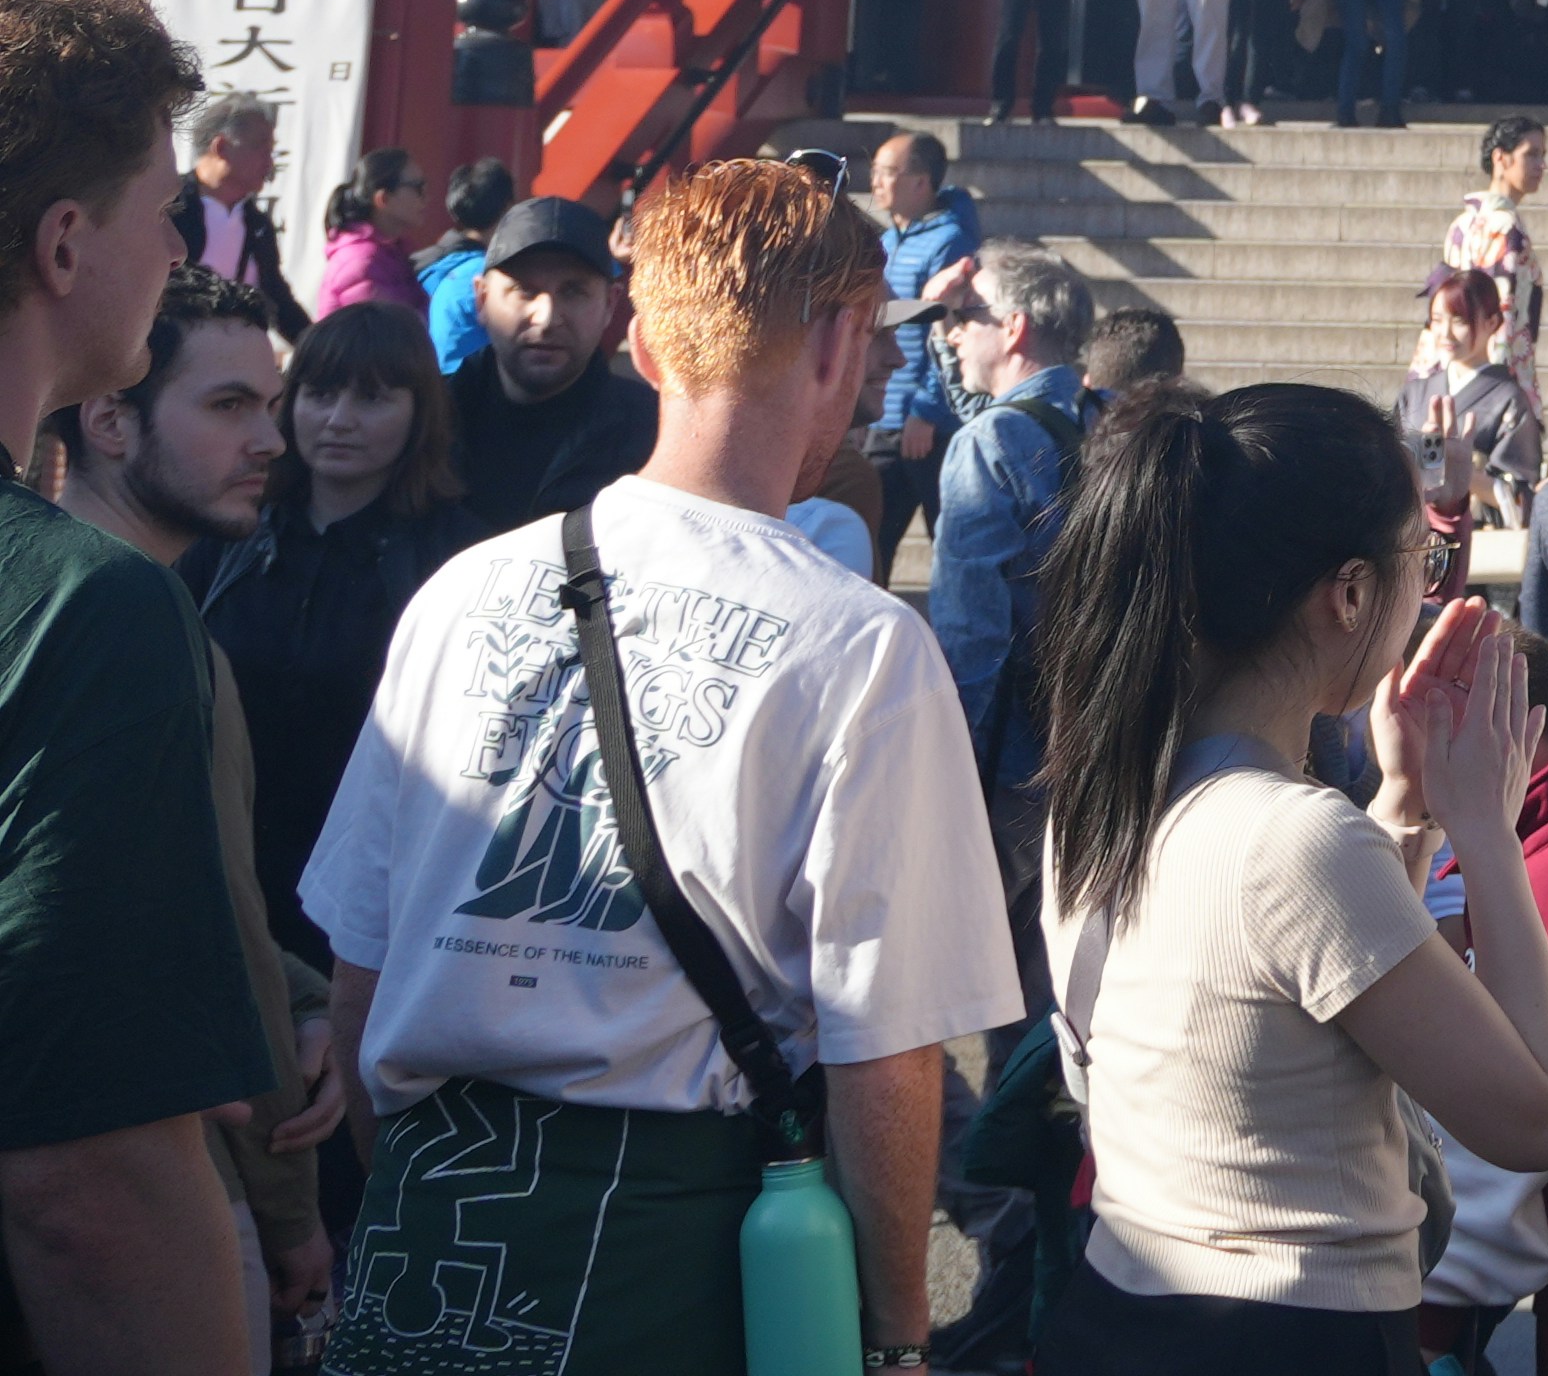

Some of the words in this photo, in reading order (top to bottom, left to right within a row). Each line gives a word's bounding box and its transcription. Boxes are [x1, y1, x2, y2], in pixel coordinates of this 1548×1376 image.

[636, 581, 790, 679] THE
[463, 629, 739, 748] THGS
[443, 935, 521, 959] ESSENCE
[524, 945, 546, 960] OF
[552, 948, 583, 965] THE
[586, 952, 649, 970] NATURE
